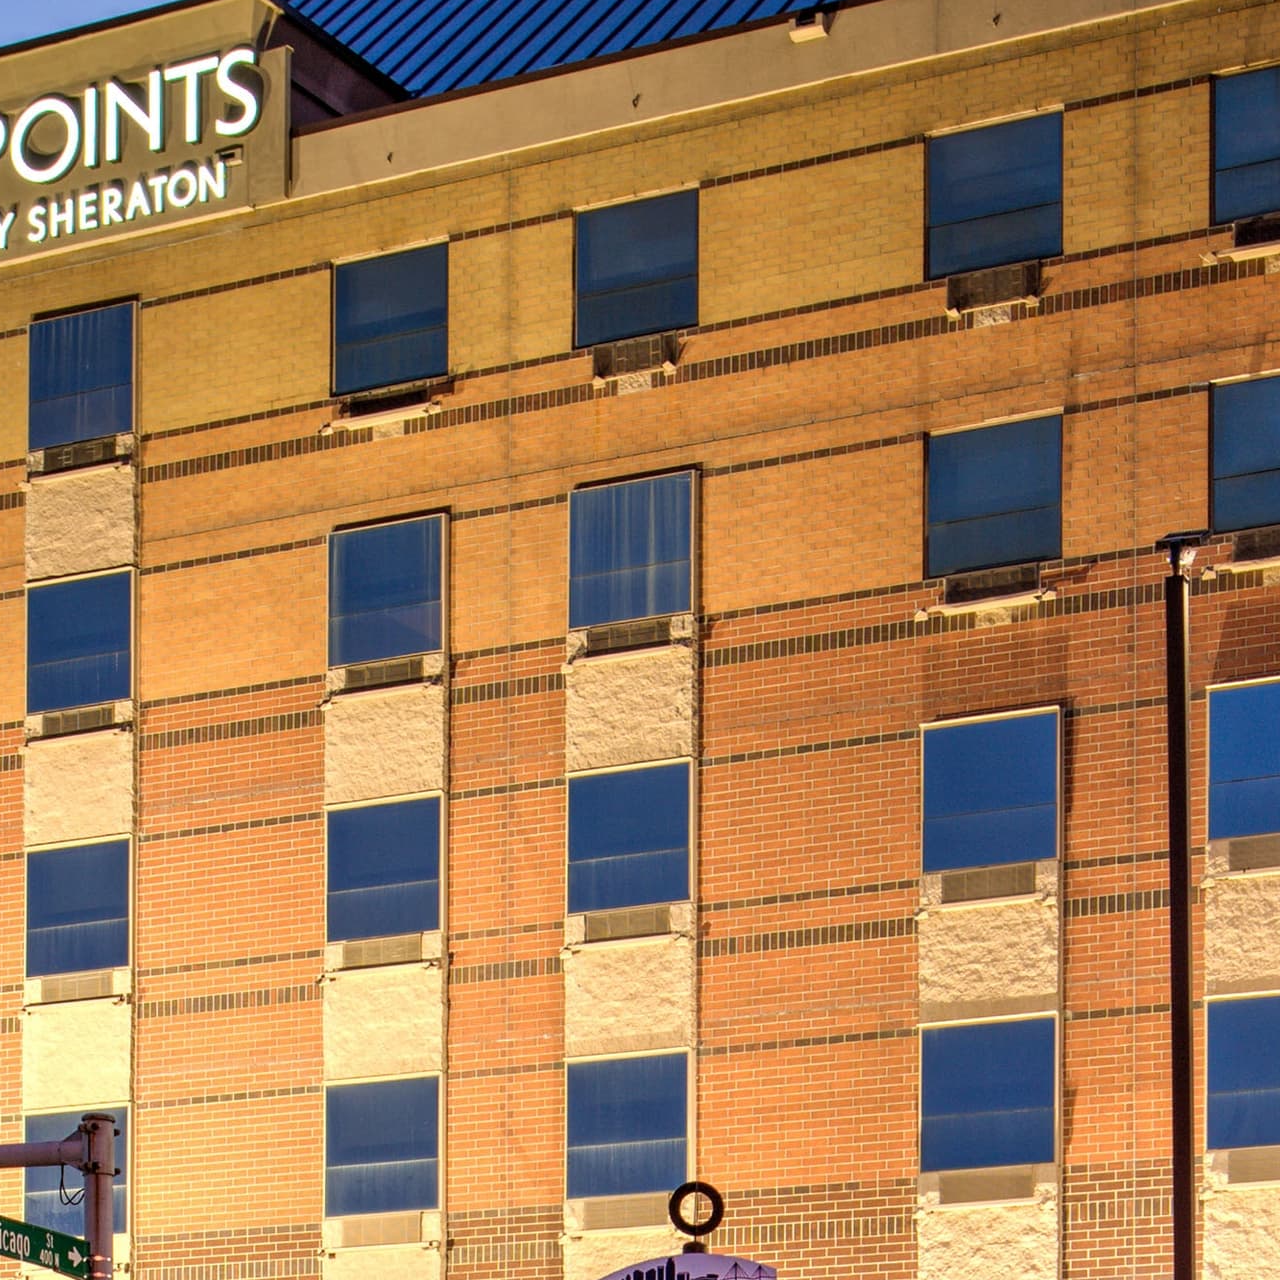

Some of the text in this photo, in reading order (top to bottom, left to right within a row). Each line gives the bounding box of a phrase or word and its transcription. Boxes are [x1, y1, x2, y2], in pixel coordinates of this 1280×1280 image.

[28, 161, 227, 243] SHERATON
[45, 1231, 54, 1249] St
[39, 1248, 54, 1266] 400
